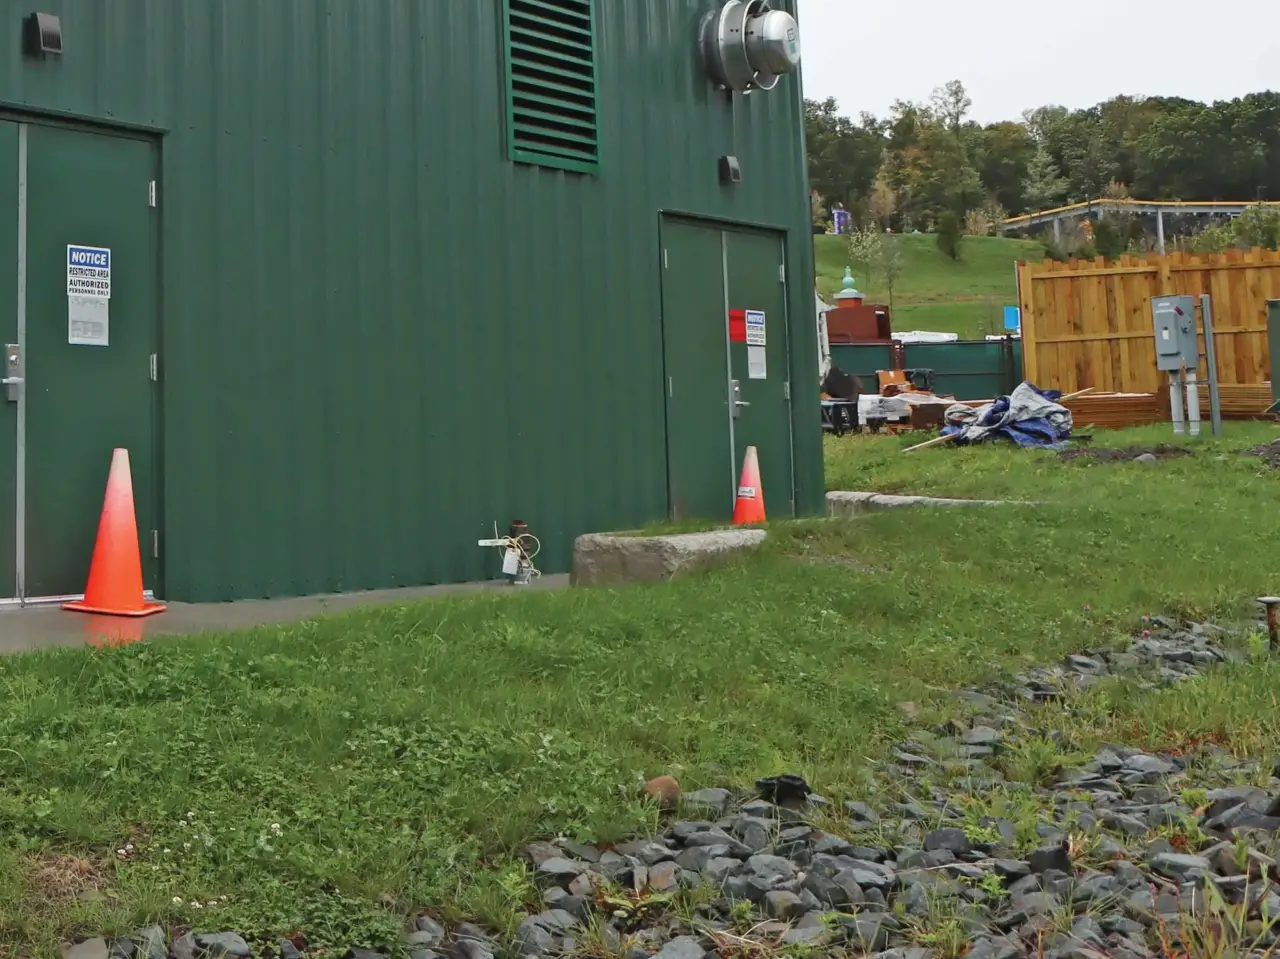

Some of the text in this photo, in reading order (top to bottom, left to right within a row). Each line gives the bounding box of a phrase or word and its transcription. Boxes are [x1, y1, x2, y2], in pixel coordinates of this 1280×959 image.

[71, 251, 107, 265] NOTICE
[69, 267, 109, 278] RESTRICTED AREA
[69, 279, 109, 289] AUTHORIZED
